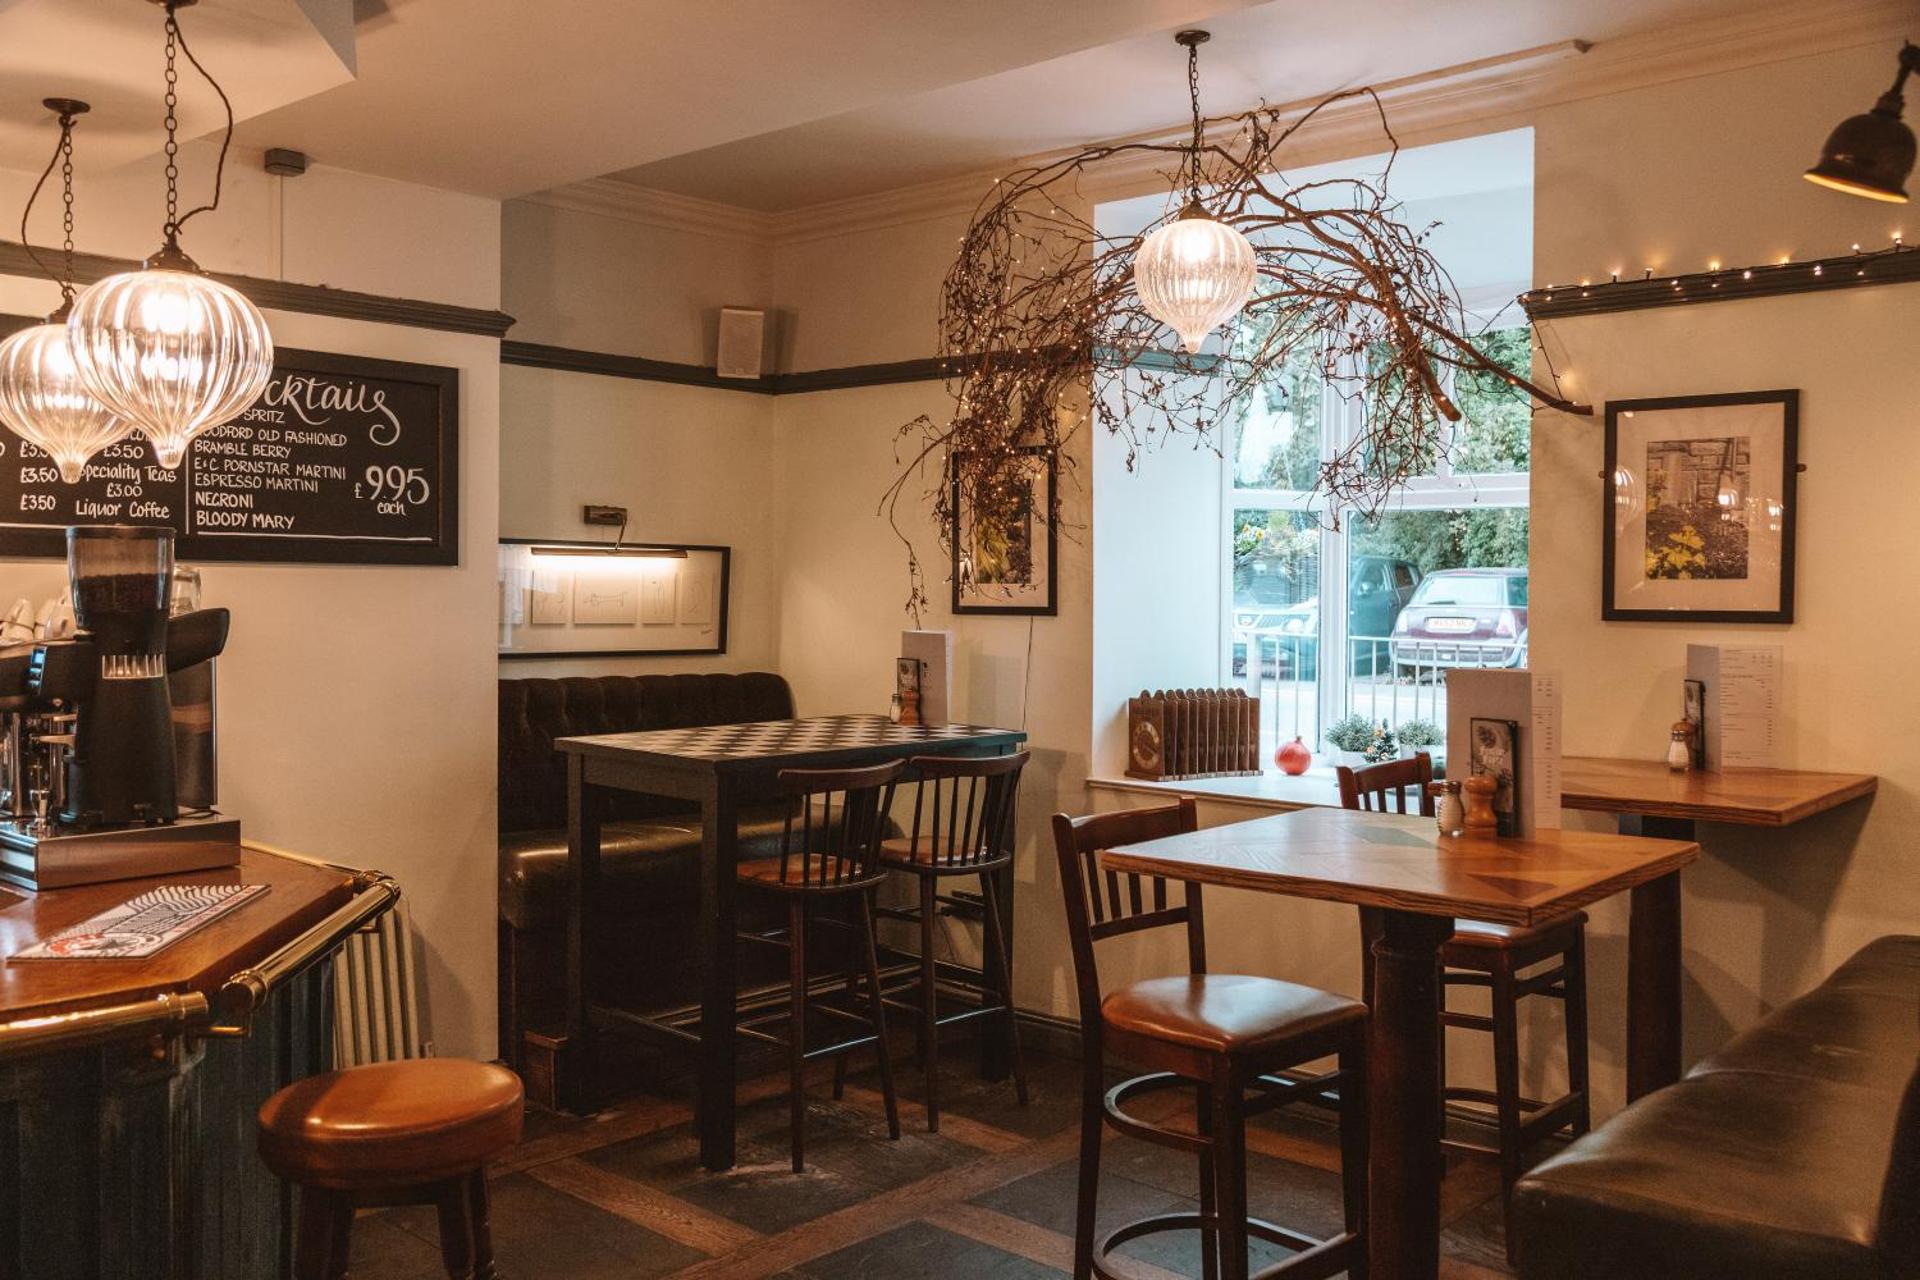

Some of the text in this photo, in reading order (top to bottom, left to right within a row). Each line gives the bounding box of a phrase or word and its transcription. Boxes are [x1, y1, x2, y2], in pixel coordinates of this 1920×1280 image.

[243, 408, 286, 423] SPRITZ
[264, 374, 400, 446] cktails
[200, 425, 347, 447] OODFORD OLD FASHIONED
[103, 443, 145, 459] £3.50
[194, 439, 291, 459] BRAMBLE BERRY
[20, 466, 59, 483] £3.50
[144, 465, 177, 483] Teas
[224, 459, 290, 476] PORNSTAR
[296, 464, 347, 480] MARTINI
[106, 482, 143, 498] £3.00
[195, 472, 319, 493] ESPRESSO MARTINI
[75, 498, 170, 518] Liquor Coffee
[195, 491, 254, 509] NEGRONI
[377, 500, 407, 516] each
[196, 510, 295, 530] BLOODY MARY
